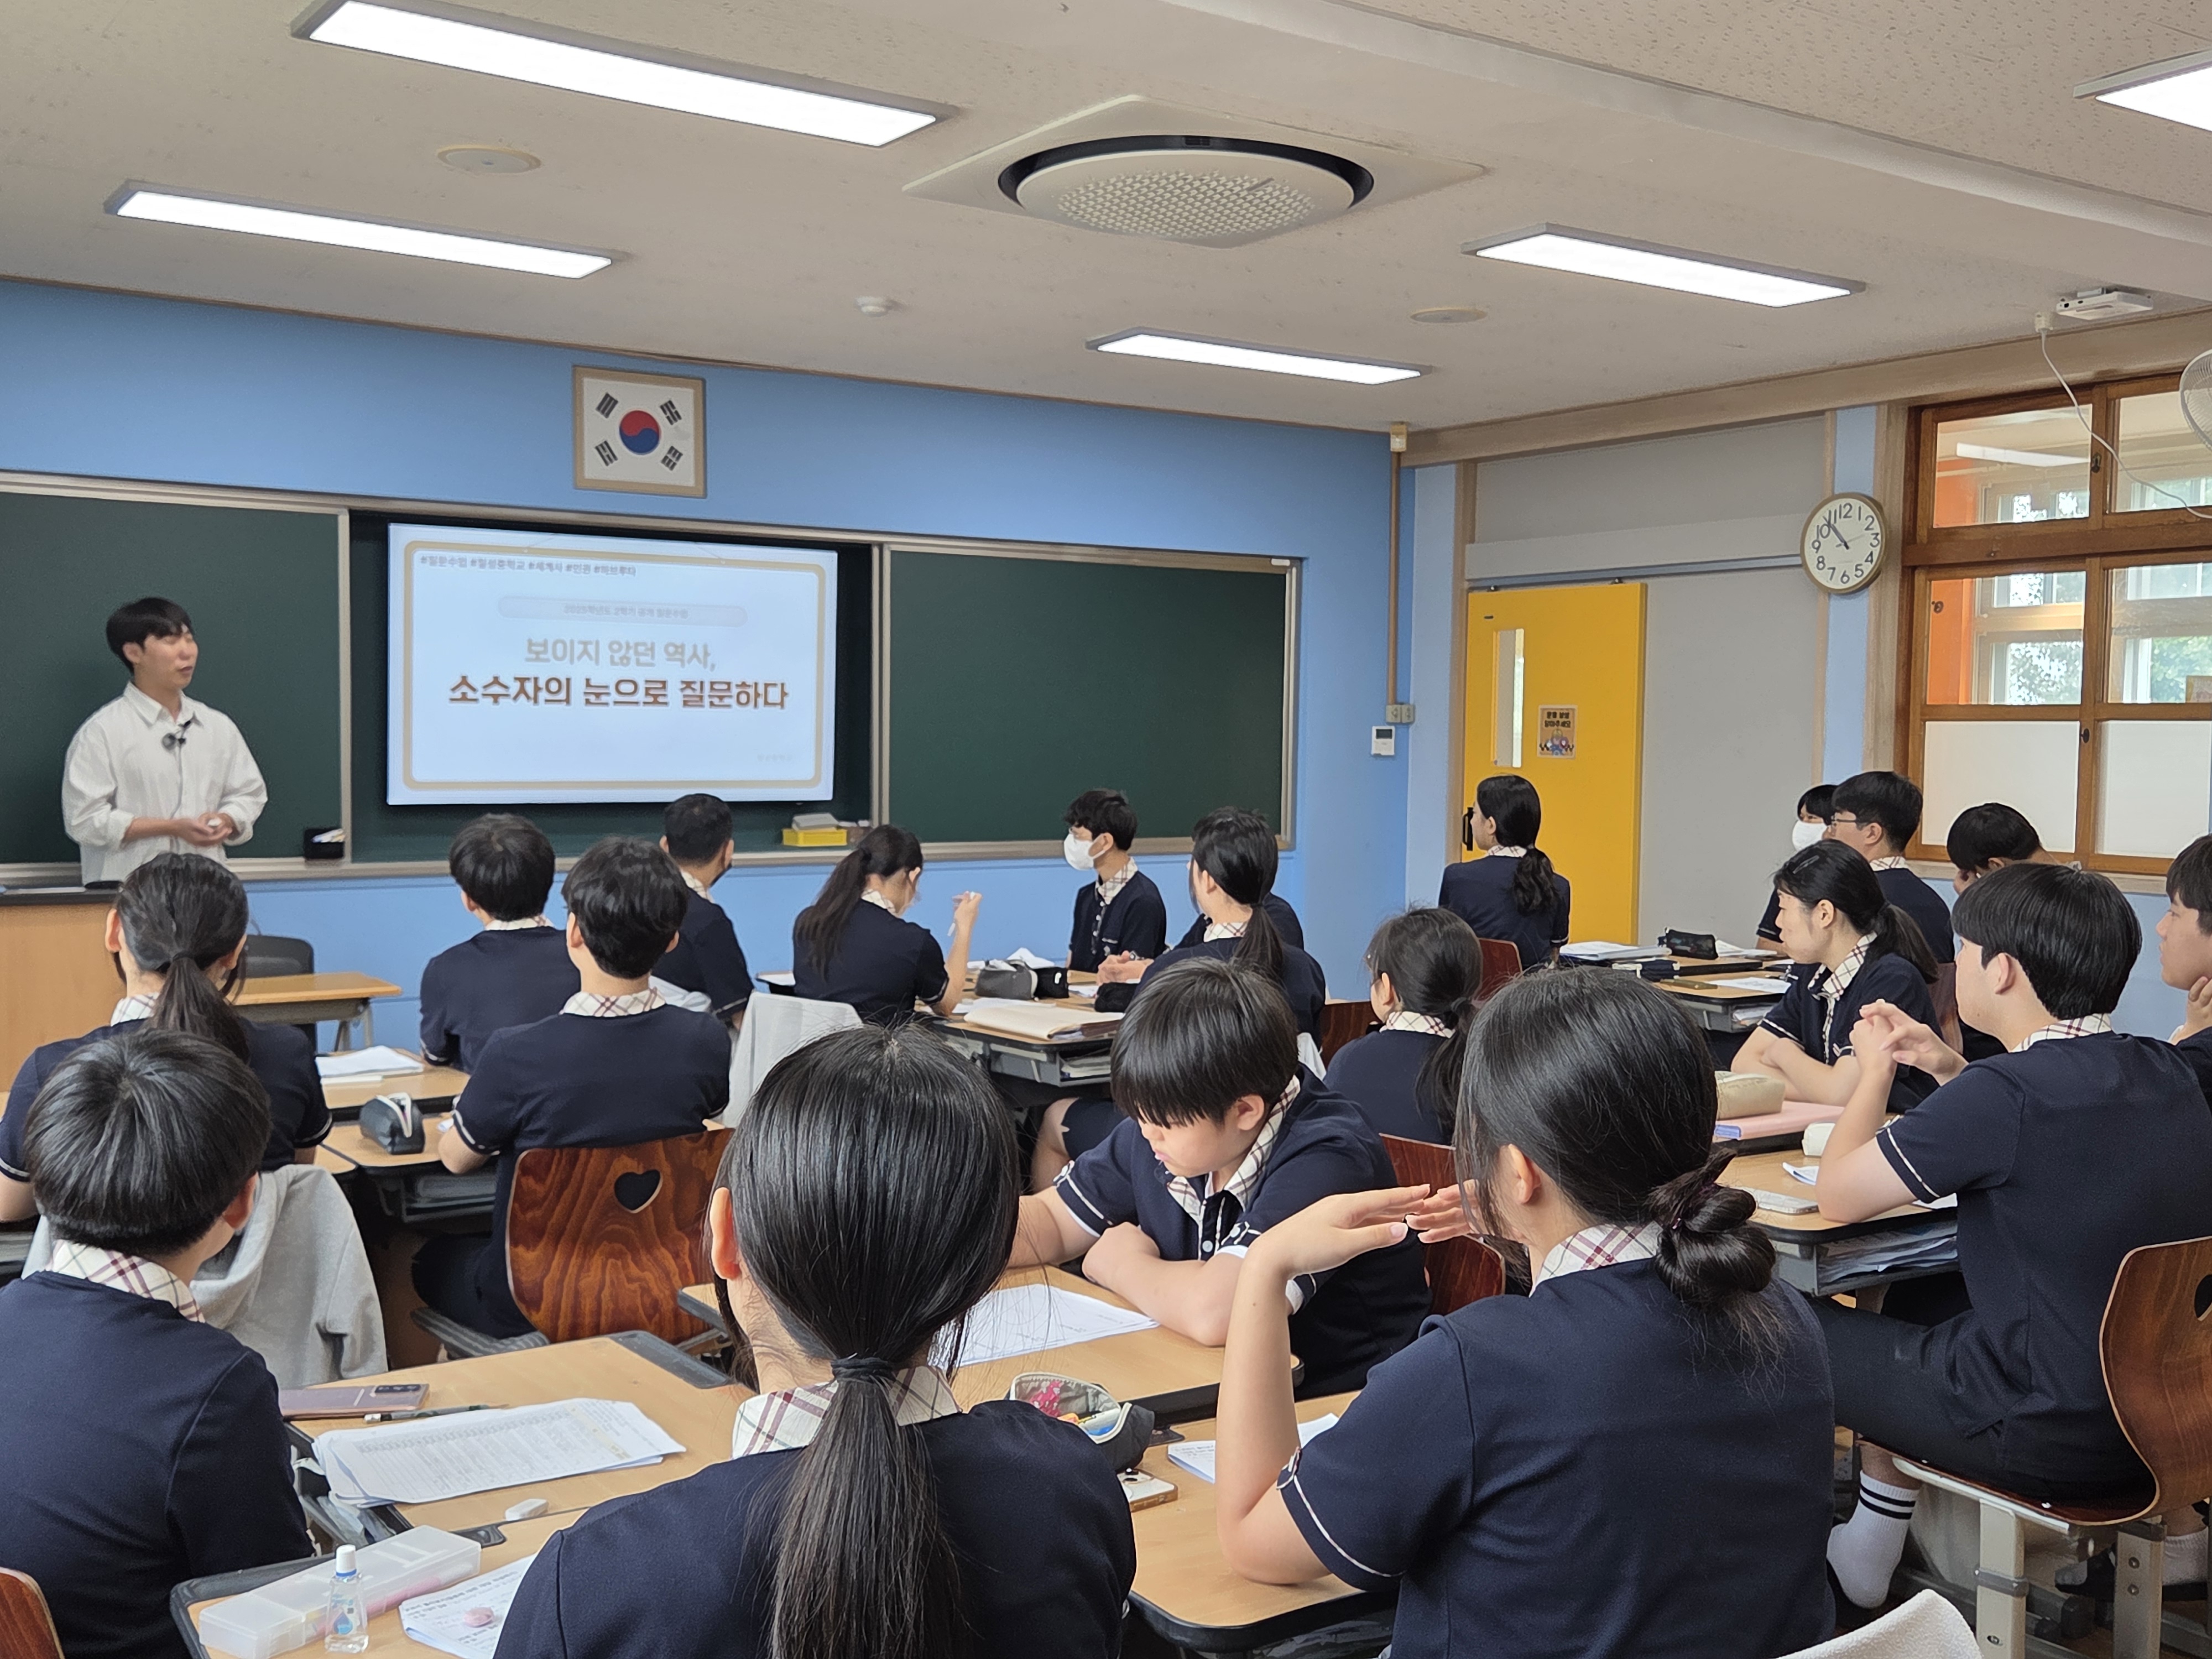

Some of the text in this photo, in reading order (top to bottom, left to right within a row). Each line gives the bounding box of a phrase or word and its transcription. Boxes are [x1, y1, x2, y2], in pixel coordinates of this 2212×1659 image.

[1839, 503, 1852, 519] 12
[1858, 505, 1861, 521] 1
[1817, 523, 1830, 539] 10
[1865, 515, 1875, 531] 2
[1812, 539, 1821, 554] 9
[1870, 533, 1880, 547] 3
[1816, 555, 1825, 571] 8
[1865, 551, 1874, 565] 4
[1827, 567, 1836, 581] 7
[1840, 570, 1850, 584] 6
[1854, 564, 1864, 578] 5
[525, 638, 716, 672] 보이지 않던 역사,
[448, 675, 789, 709] 소수자의 눈으로 질문하다
